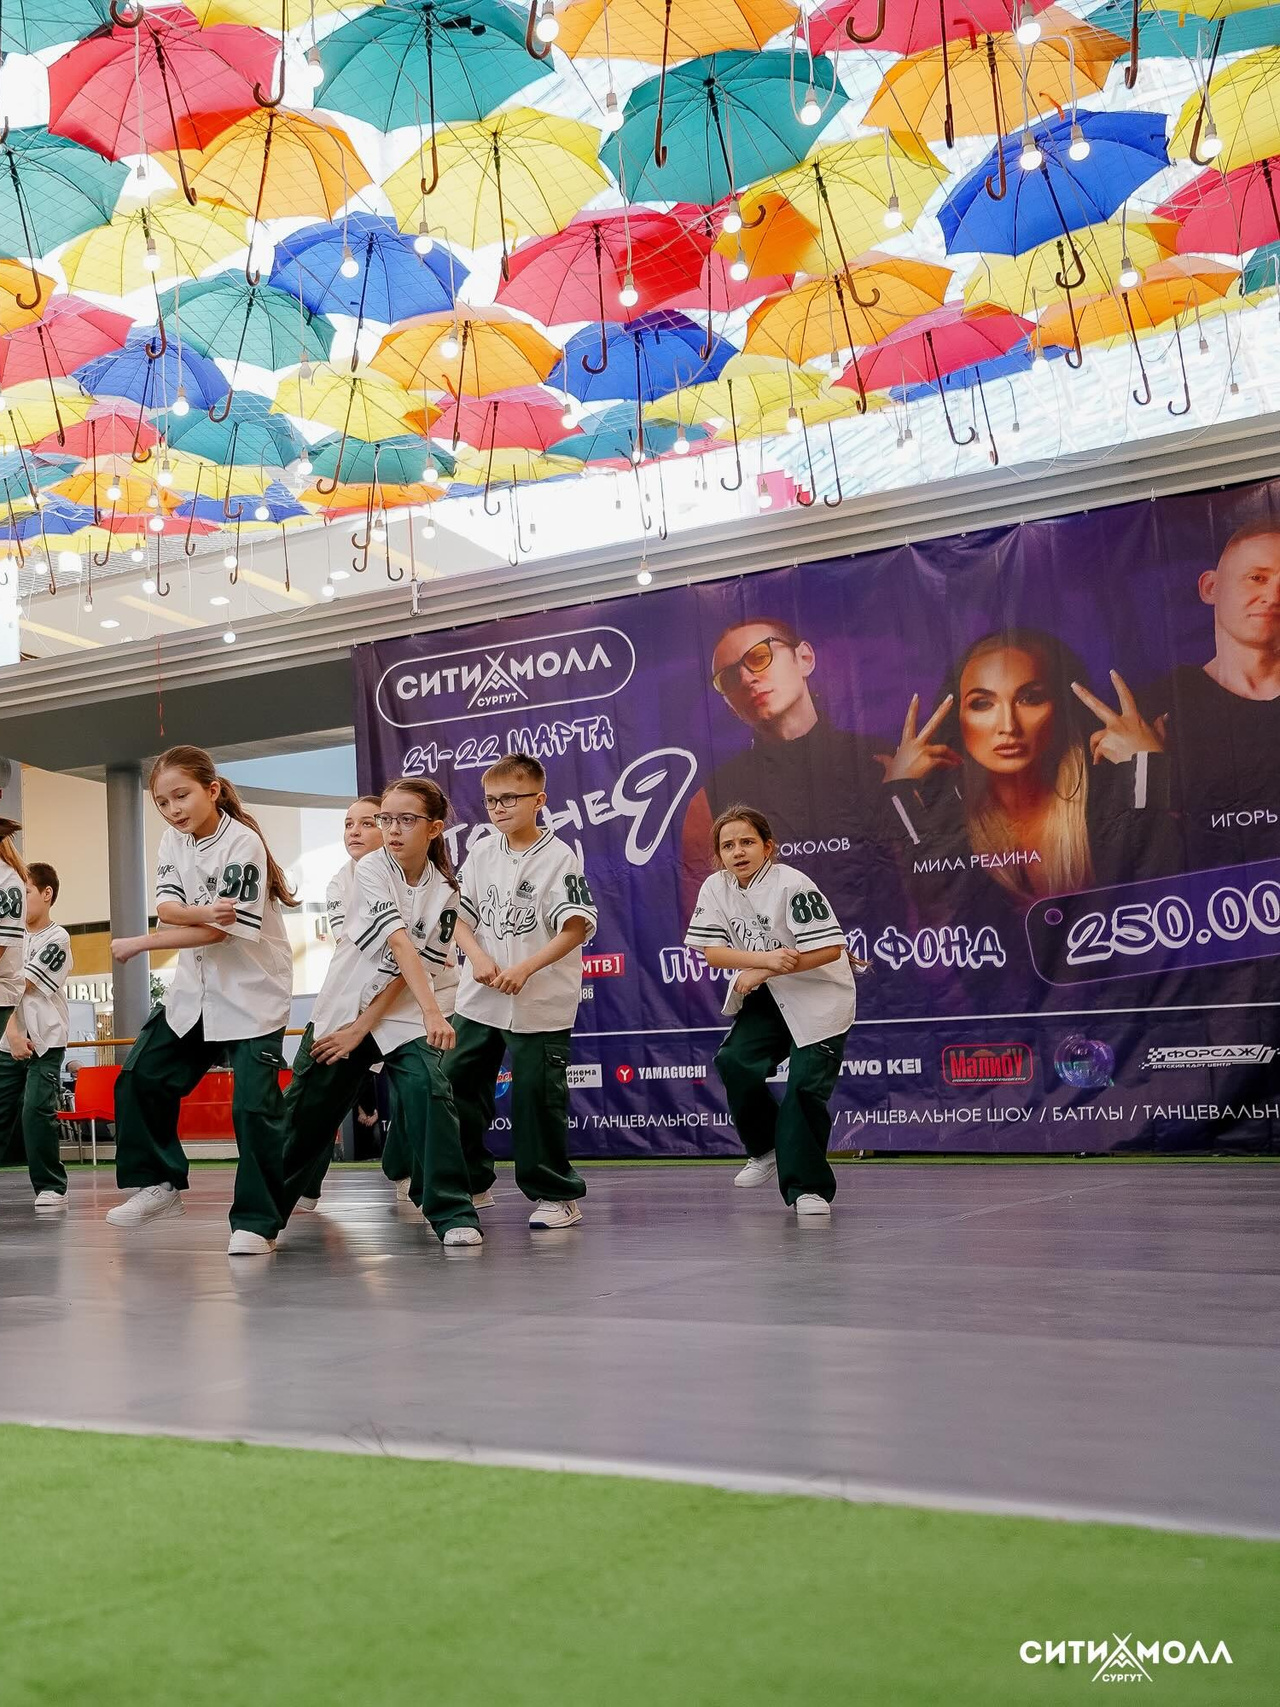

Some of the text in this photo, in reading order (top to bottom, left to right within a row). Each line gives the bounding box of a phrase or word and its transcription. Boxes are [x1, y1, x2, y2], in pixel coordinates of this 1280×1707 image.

[396, 643, 612, 700] СИТИ МОЛЛ
[477, 692, 518, 707] СУРГУТ
[402, 715, 614, 777] 21-22 МАРТА
[1211, 809, 1278, 828] ИГОРЬ
[913, 850, 1041, 873] МИЛА РЕДИНА
[563, 873, 595, 906] 88
[790, 890, 831, 924] 88
[38, 942, 67, 973] 88
[874, 925, 1006, 971] ФОНД
[1167, 1047, 1257, 1058] ФОРСАЖ
[568, 1077, 585, 1085] арк
[638, 1065, 707, 1080] YAMAGUCHI
[592, 1113, 709, 1130] ТАНЦЕВАЛЬНОЕ
[845, 1107, 982, 1126] ТАНЦЕВАЛЬНОЕ
[987, 1106, 1034, 1122] ШОУ
[1053, 1106, 1123, 1121] БАТТЛЫ
